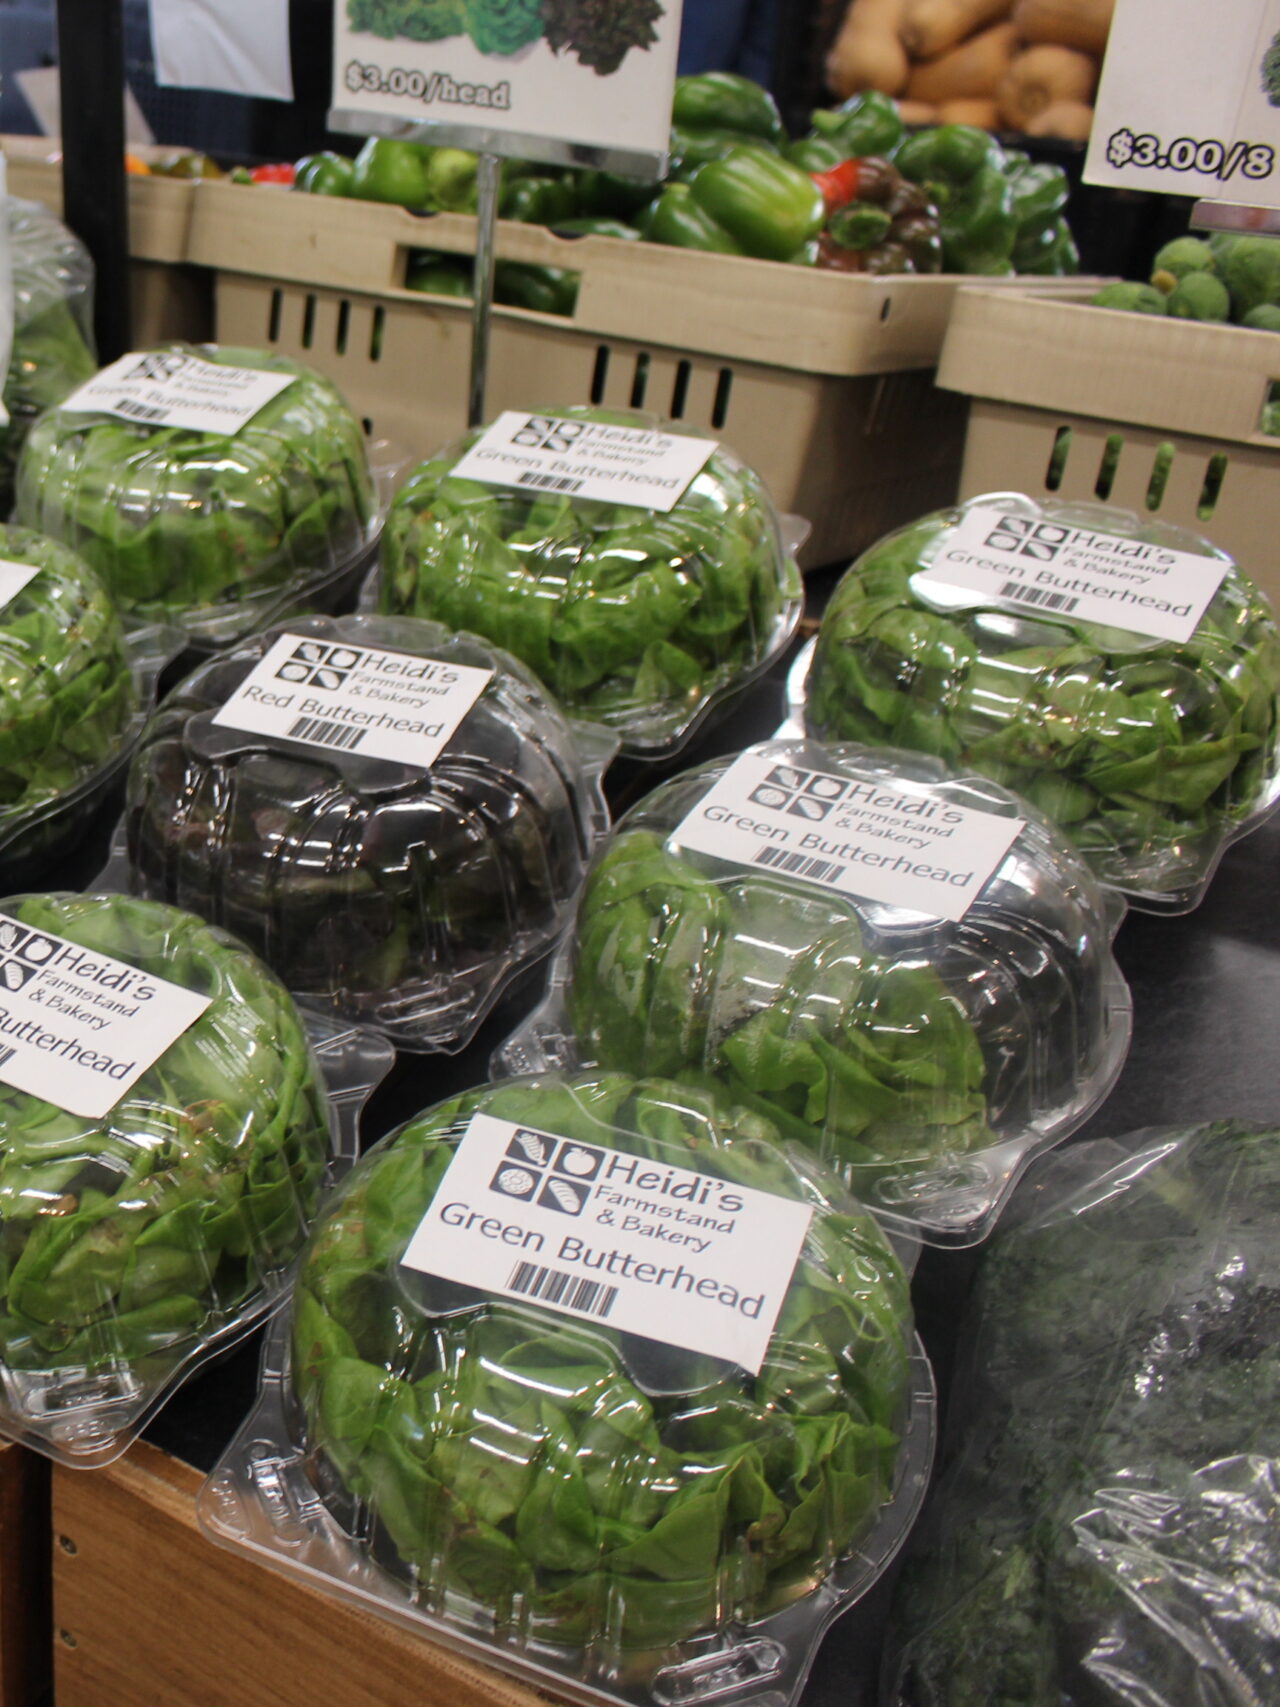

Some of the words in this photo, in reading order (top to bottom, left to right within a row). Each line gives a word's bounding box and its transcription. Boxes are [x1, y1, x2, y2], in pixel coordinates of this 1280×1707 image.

[345, 60, 511, 110] $3.00/head
[1107, 128, 1275, 181] $3.00/8
[583, 423, 673, 448] Heidi's
[476, 449, 543, 469] Green
[550, 460, 680, 489] Butterhead
[1062, 546, 1170, 576] Farmstand
[1070, 531, 1176, 565] Heidi's
[946, 549, 1025, 579] Green
[1034, 571, 1193, 618] Butterhead
[1063, 558, 1078, 569] &
[1082, 560, 1152, 585] Bakery
[349, 671, 450, 697] Farmstand
[360, 653, 460, 685] Heidi's
[241, 685, 295, 709] Red
[298, 698, 445, 738] Butterhead
[348, 686, 361, 696] &
[366, 688, 430, 709] Bakery
[834, 802, 955, 839] Farmstand
[844, 783, 964, 825] Heidi's
[701, 805, 790, 842] Green
[798, 832, 974, 888] Butterhead
[834, 816, 851, 829] &
[856, 819, 933, 850] Bakery
[35, 969, 140, 1019] Farmstand
[53, 947, 157, 1001] Heidi's
[28, 989, 44, 1004] &
[48, 995, 112, 1032] Bakery
[603, 1154, 744, 1213] Heidi's
[593, 1185, 736, 1235] Farmstand
[595, 1209, 615, 1226] &
[621, 1216, 712, 1254] Bakery
[439, 1202, 544, 1253] Green
[557, 1236, 766, 1320] Butterhead
